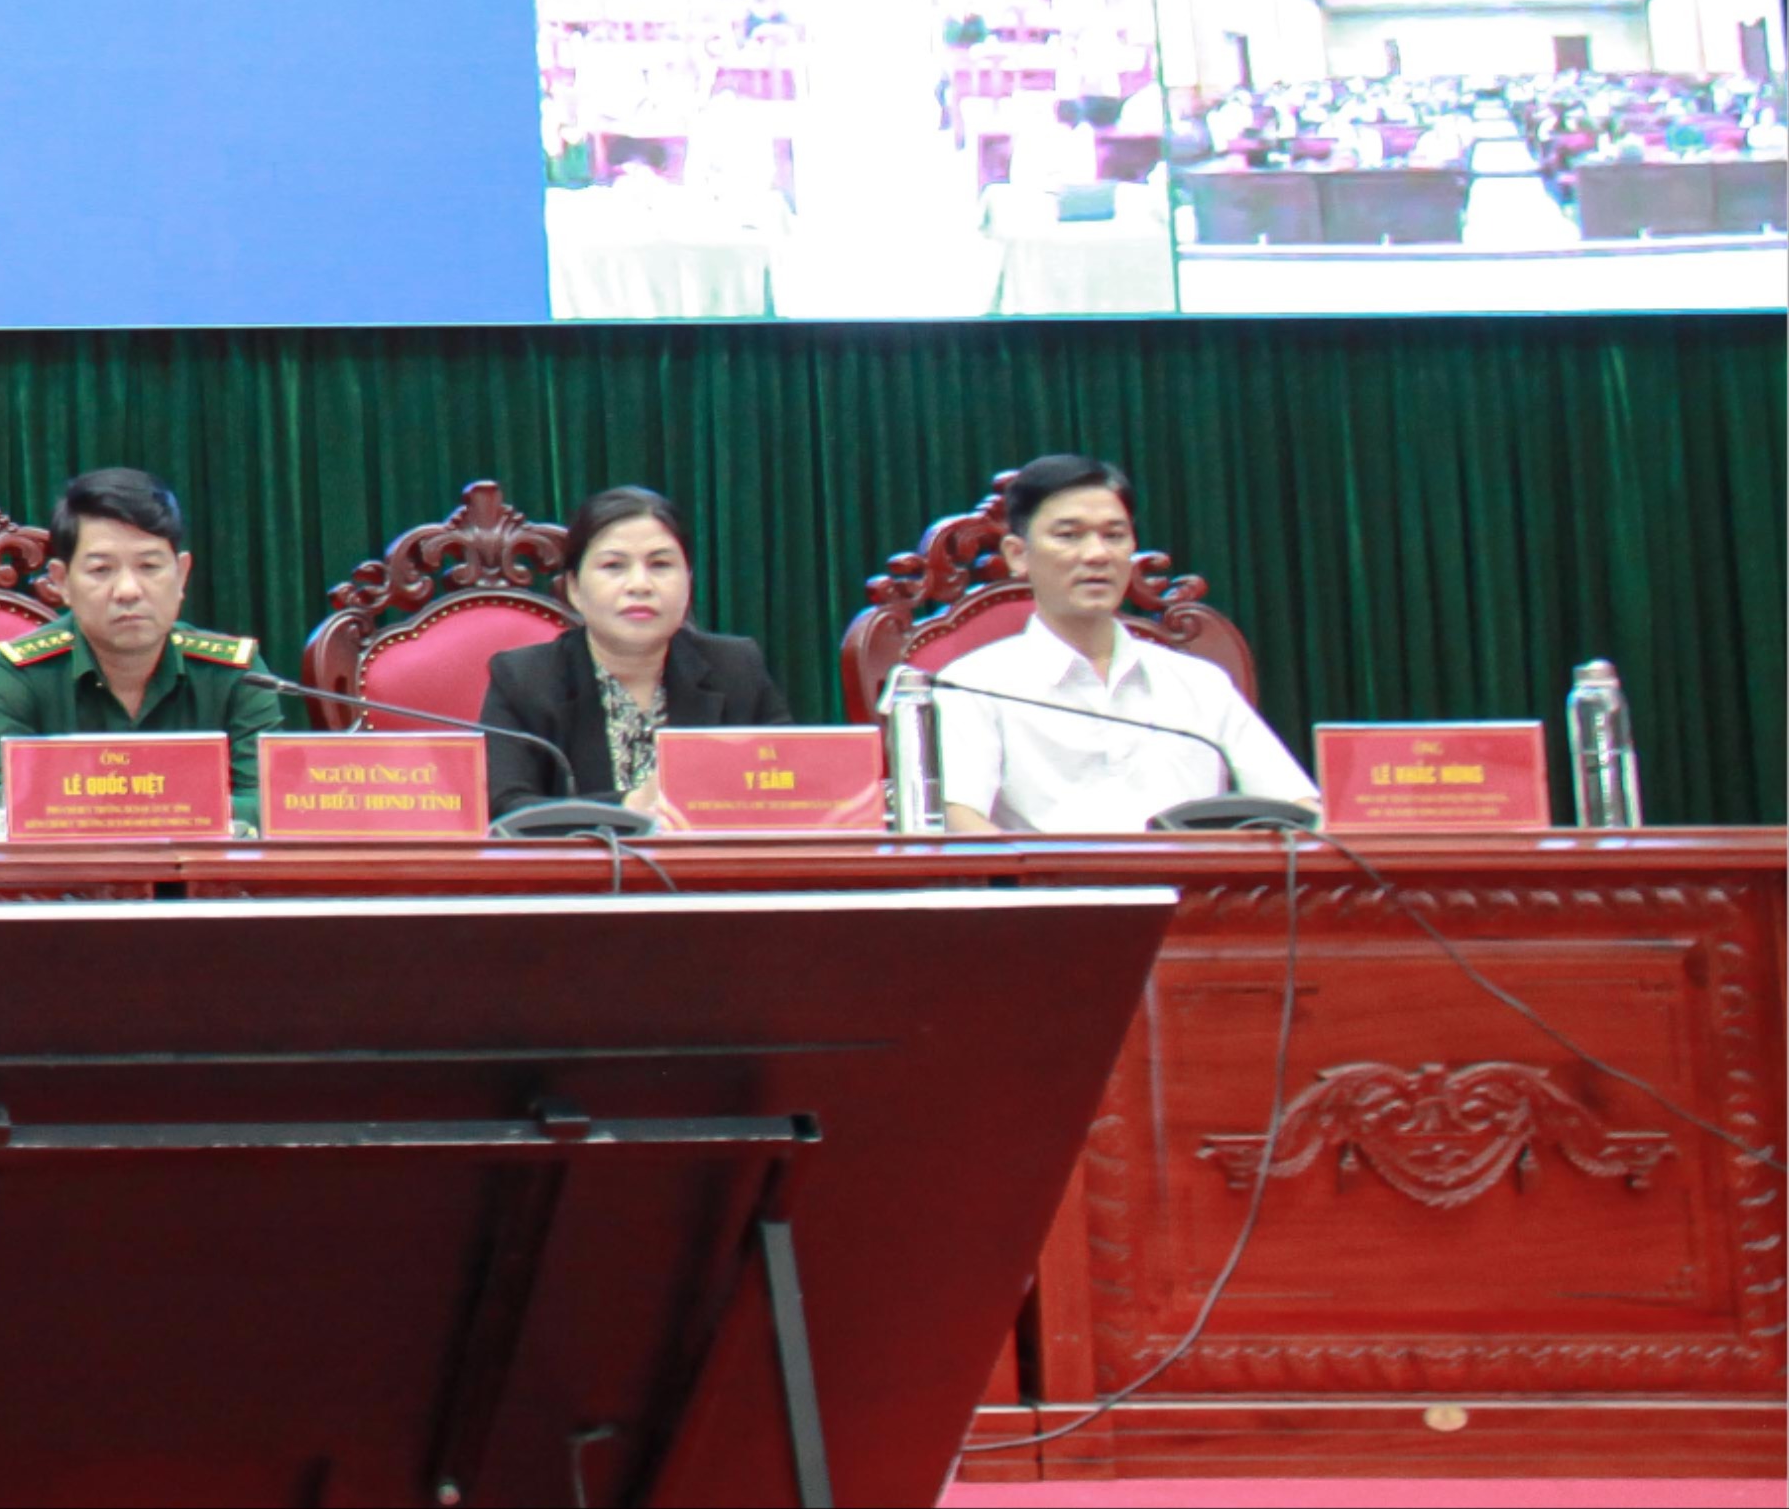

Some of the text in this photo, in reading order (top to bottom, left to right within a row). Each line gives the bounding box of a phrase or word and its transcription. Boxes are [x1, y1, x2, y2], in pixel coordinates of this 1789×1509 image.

[63, 770, 165, 798] LÊ QUỐC VIỆT
